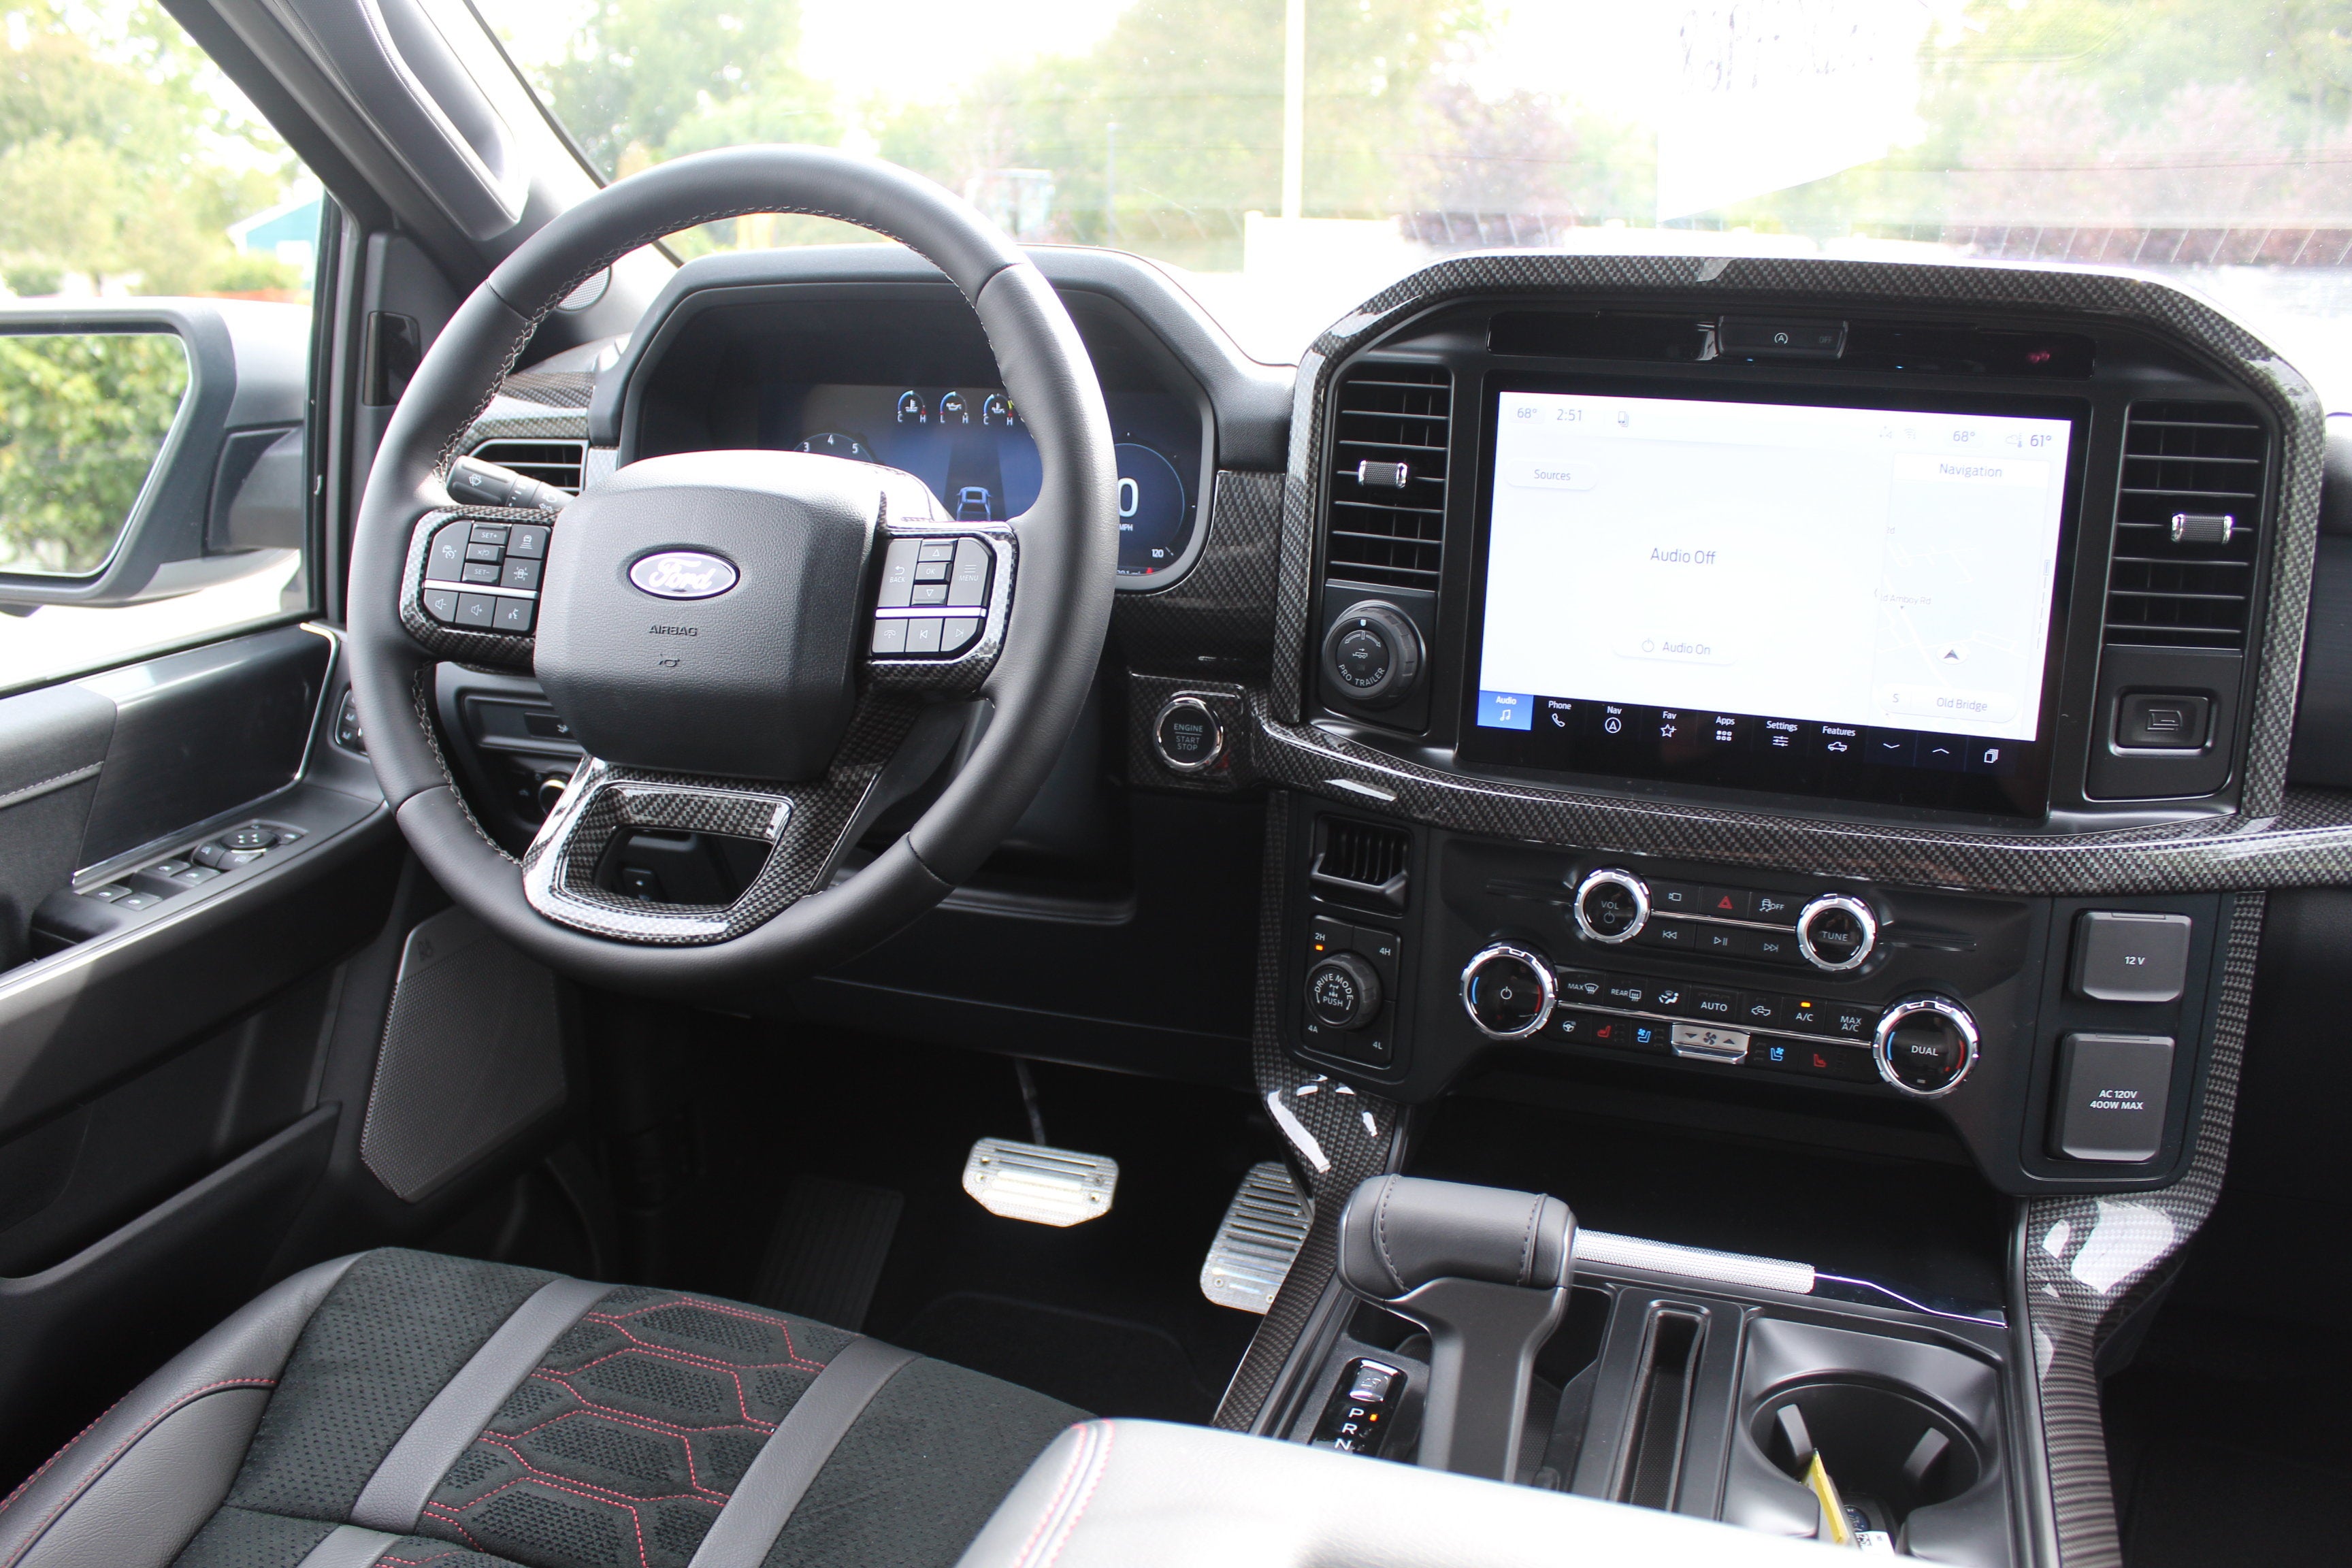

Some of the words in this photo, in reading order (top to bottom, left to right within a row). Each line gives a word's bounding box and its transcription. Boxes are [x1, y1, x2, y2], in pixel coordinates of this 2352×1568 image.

[897, 414, 903, 423] C
[919, 414, 926, 423] H
[1517, 408, 1537, 419] 68°
[1556, 408, 1582, 421] 2:51
[940, 415, 945, 423] L
[962, 415, 968, 423] H
[983, 416, 989, 425] C
[1007, 417, 1013, 426] H
[828, 434, 834, 445] 4
[1953, 431, 1976, 442] 68°
[2030, 434, 2052, 447] 61°
[804, 442, 810, 453] 3
[852, 443, 858, 454] 5
[1534, 469, 1571, 480] Sources
[1939, 463, 2002, 478] Navigation
[1118, 478, 1139, 517] 0
[1152, 549, 1164, 557] 120
[1650, 547, 1690, 564] Audio
[1695, 550, 1716, 564] Off
[649, 558, 717, 590] Ford
[1920, 596, 1931, 605] Rd
[649, 625, 698, 636] AIRBAG
[1662, 641, 1693, 654] Audio
[1695, 644, 1711, 655] On
[1339, 664, 1352, 681] PRO
[1354, 668, 1385, 686] TRAILER
[1496, 696, 1517, 705] Audio
[1893, 693, 1899, 702] S
[1548, 700, 1571, 710] Phone
[1936, 697, 1954, 708] Old
[1956, 699, 1987, 712] Bridge
[1607, 706, 1622, 715] Nav
[1663, 711, 1677, 720] Fav
[1716, 716, 1735, 726] Apps
[1766, 720, 1798, 732] Settings
[1173, 723, 1203, 733] ENGINE
[1822, 725, 1856, 737] Features
[1176, 736, 1200, 744] START
[1601, 900, 1619, 910] VOL
[1315, 932, 1325, 941] 2H
[1822, 930, 1848, 942] TUNE
[1379, 947, 1391, 956] 4H
[2125, 956, 2136, 964] 12
[2137, 957, 2145, 965] V
[1314, 973, 1334, 993] DRIVE
[1335, 975, 1354, 1000] MODE
[1322, 996, 1343, 1007] PUSH
[1701, 1002, 1728, 1012] AUTO
[1795, 1013, 1814, 1022] A/C
[1840, 1015, 1862, 1025] MAX
[1308, 1024, 1318, 1033] 4A
[1841, 1022, 1859, 1032] A/C
[1373, 1041, 1382, 1049] 4L
[1911, 1045, 1939, 1056] DUAL
[2099, 1090, 2112, 1098] AC
[2114, 1090, 2138, 1099] 120V
[2090, 1100, 2119, 1110] 400W
[2121, 1102, 2144, 1110] MAX
[1348, 1407, 1365, 1418] P
[1341, 1422, 1358, 1435] R
[1335, 1437, 1352, 1451] N
